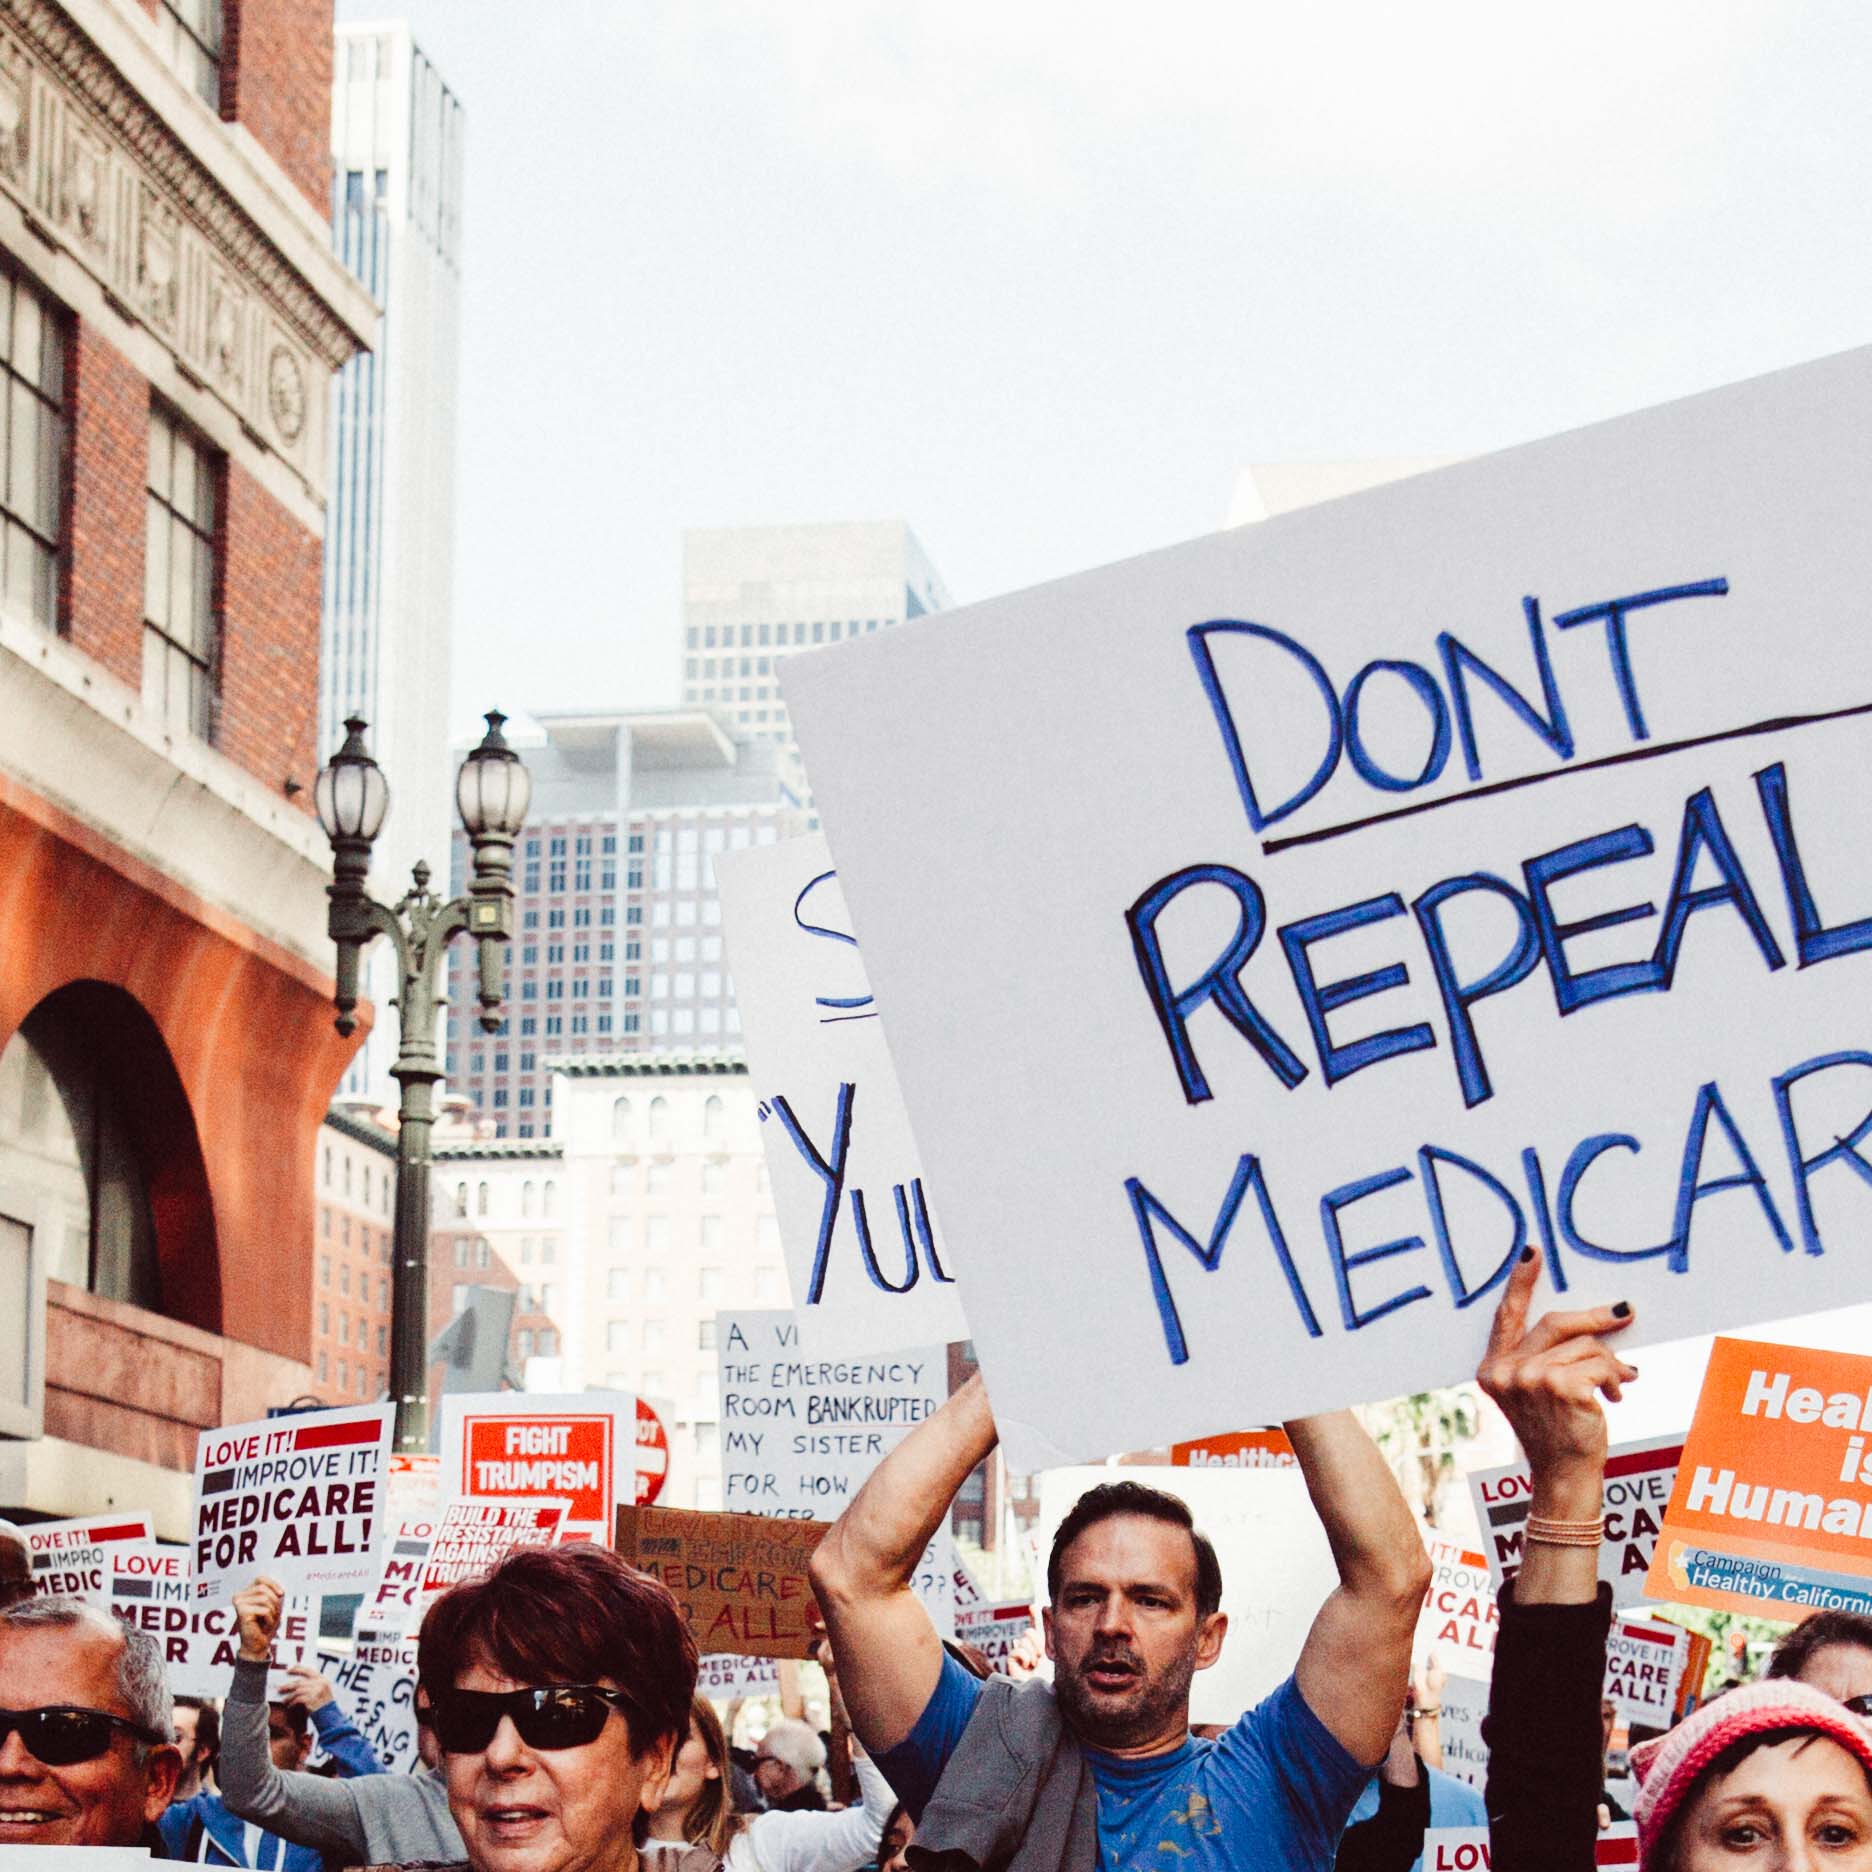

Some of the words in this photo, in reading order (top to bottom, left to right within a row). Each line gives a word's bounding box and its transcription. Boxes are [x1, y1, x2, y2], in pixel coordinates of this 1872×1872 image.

[1186, 575, 1728, 834] DONT
[728, 1323, 748, 1351] A
[725, 1364, 760, 1383] THE
[771, 1363, 925, 1387] EMERGENCY
[727, 1394, 795, 1417] ROOM
[808, 1396, 936, 1424] BANKRUPTED
[204, 1436, 259, 1468] LOVE
[264, 1431, 295, 1457] IT!
[505, 1426, 571, 1455] FIGHT
[727, 1432, 764, 1456] MY
[234, 1454, 341, 1490] IMPROVE
[348, 1449, 379, 1476] IT!
[476, 1461, 598, 1491] TRUMPISM
[728, 1474, 780, 1496] FOR
[800, 1476, 848, 1495] HOW
[1481, 1472, 1533, 1503] LOV
[198, 1481, 376, 1536] MEDICARE
[448, 1507, 499, 1526] BUILD
[503, 1508, 540, 1527] THE
[30, 1532, 63, 1550] OVE
[399, 1522, 432, 1537] LO
[440, 1526, 553, 1546] RESISTANCE
[53, 1549, 104, 1567] IMPRO
[198, 1530, 258, 1574] FOR
[275, 1519, 372, 1558] ALL!
[113, 1555, 179, 1577] LOVE
[1694, 1550, 1782, 1582] Campaign
[32, 1569, 102, 1597] MEDIC
[1691, 1568, 1776, 1600] Healthy
[356, 1647, 413, 1664] MEDIC
[317, 1652, 374, 1693] THE
[1608, 1656, 1671, 1685] CARE
[1609, 1680, 1667, 1706] ALL!
